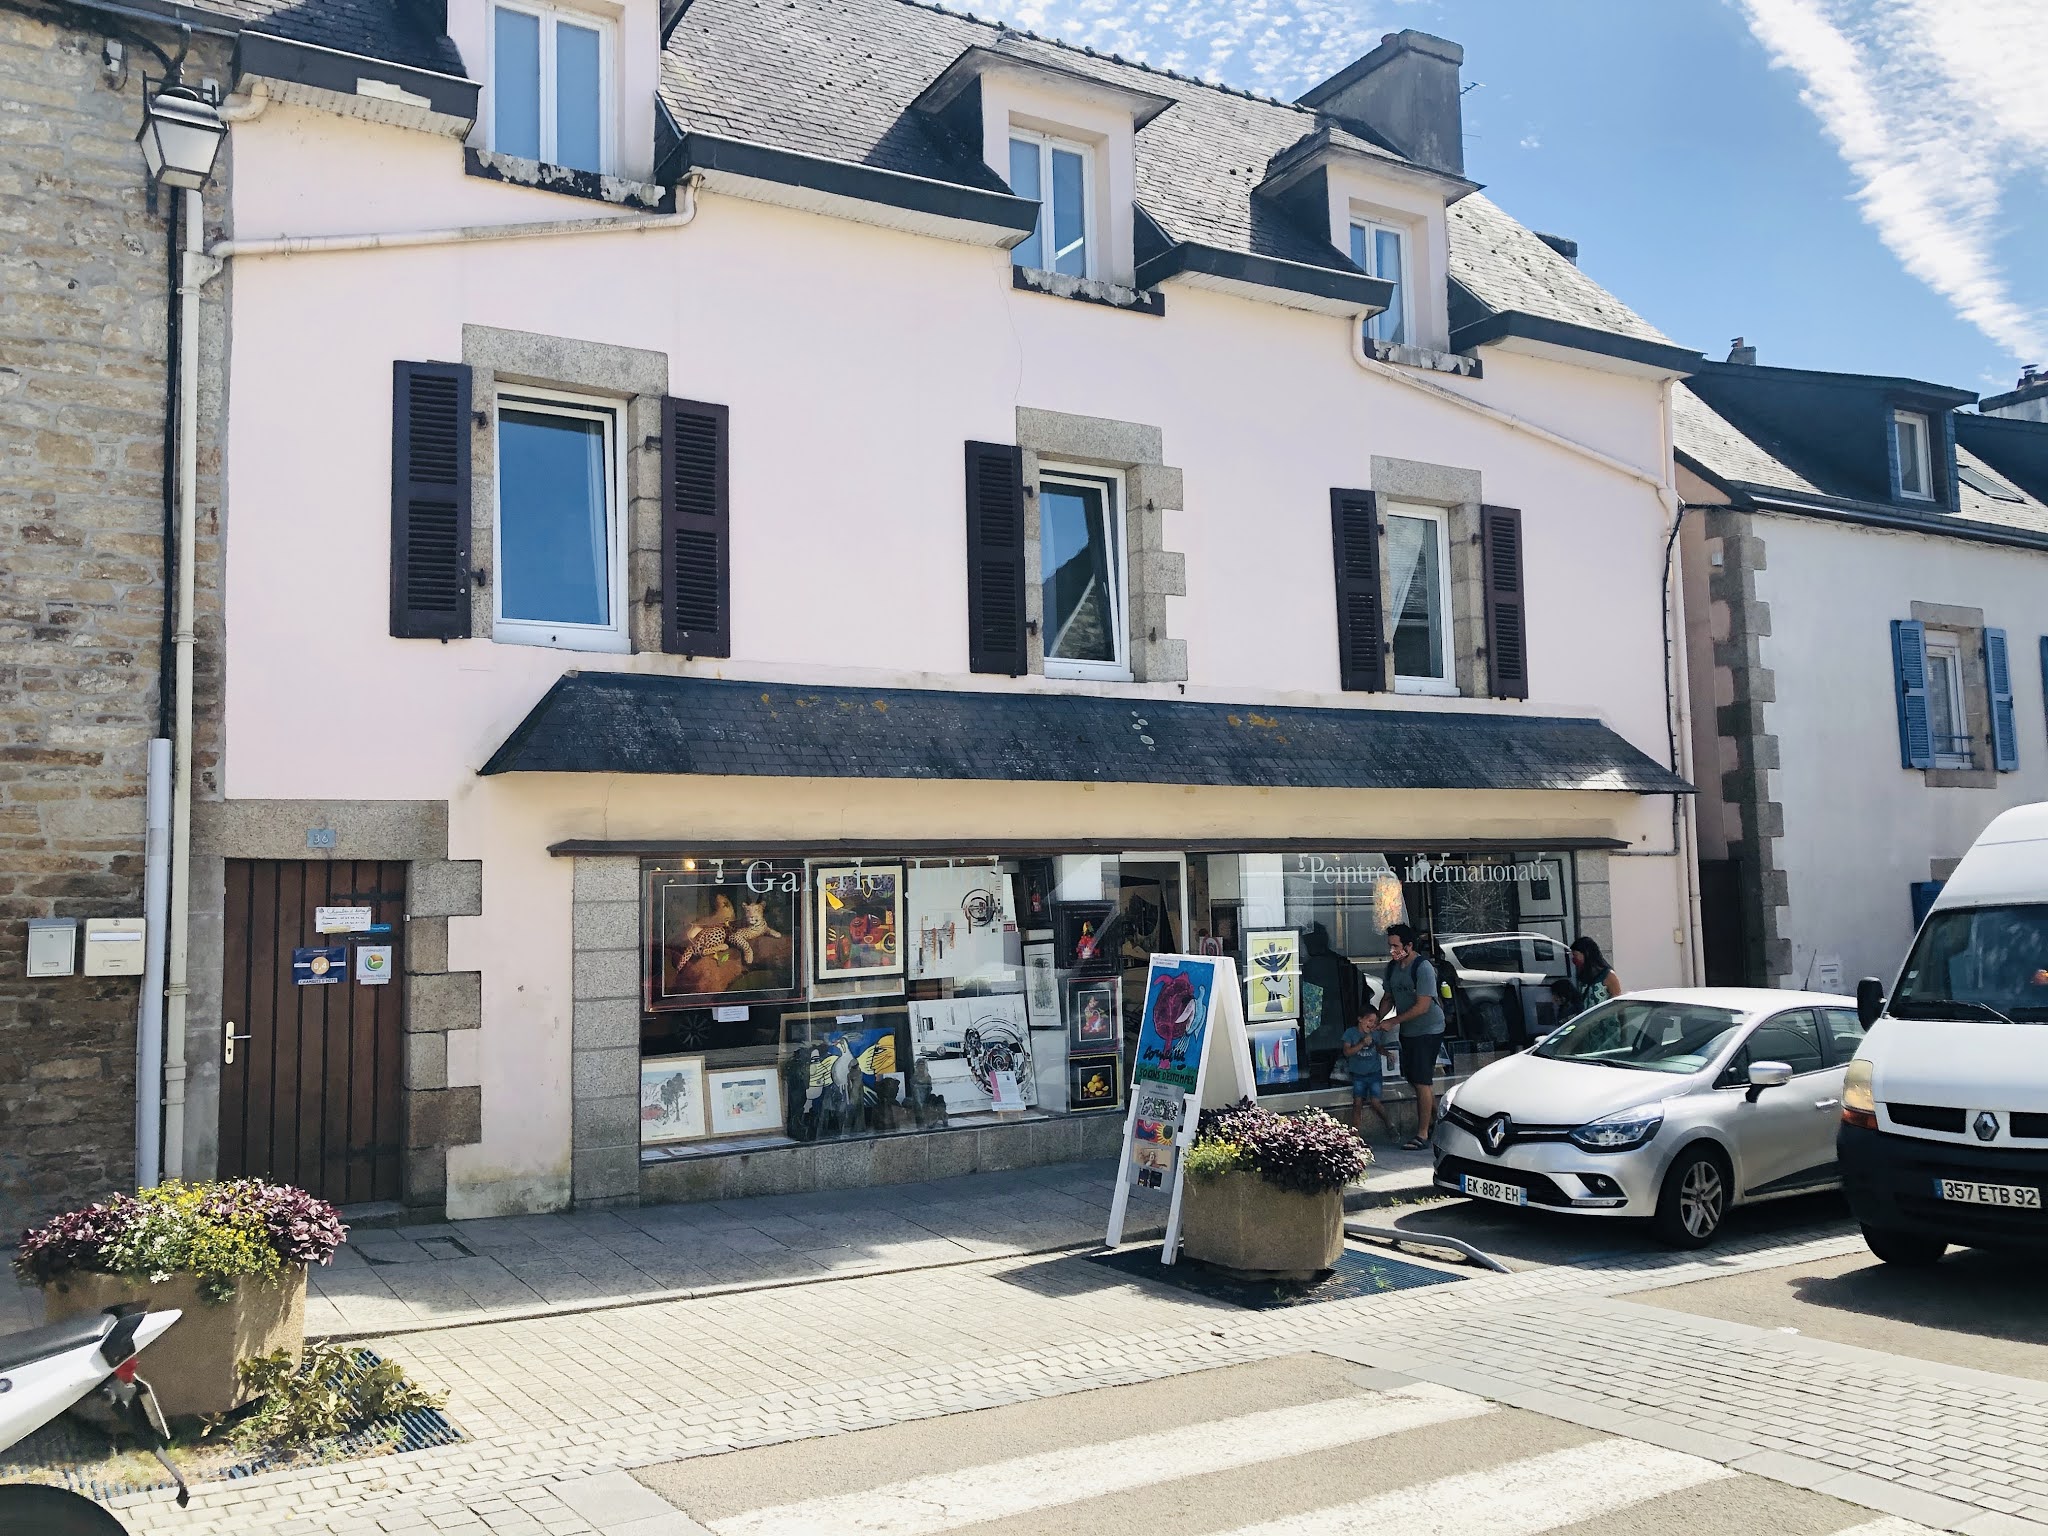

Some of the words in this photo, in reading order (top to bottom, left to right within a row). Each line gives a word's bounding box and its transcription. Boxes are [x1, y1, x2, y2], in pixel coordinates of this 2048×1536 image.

[313, 833, 329, 844] 36
[745, 858, 884, 894] Galerie
[1309, 856, 1396, 885] Peintres
[1404, 855, 1553, 884] internationaux
[1944, 1182, 1973, 1200] 357
[1978, 1185, 2010, 1203] ETB
[2014, 1188, 2037, 1206] 92
